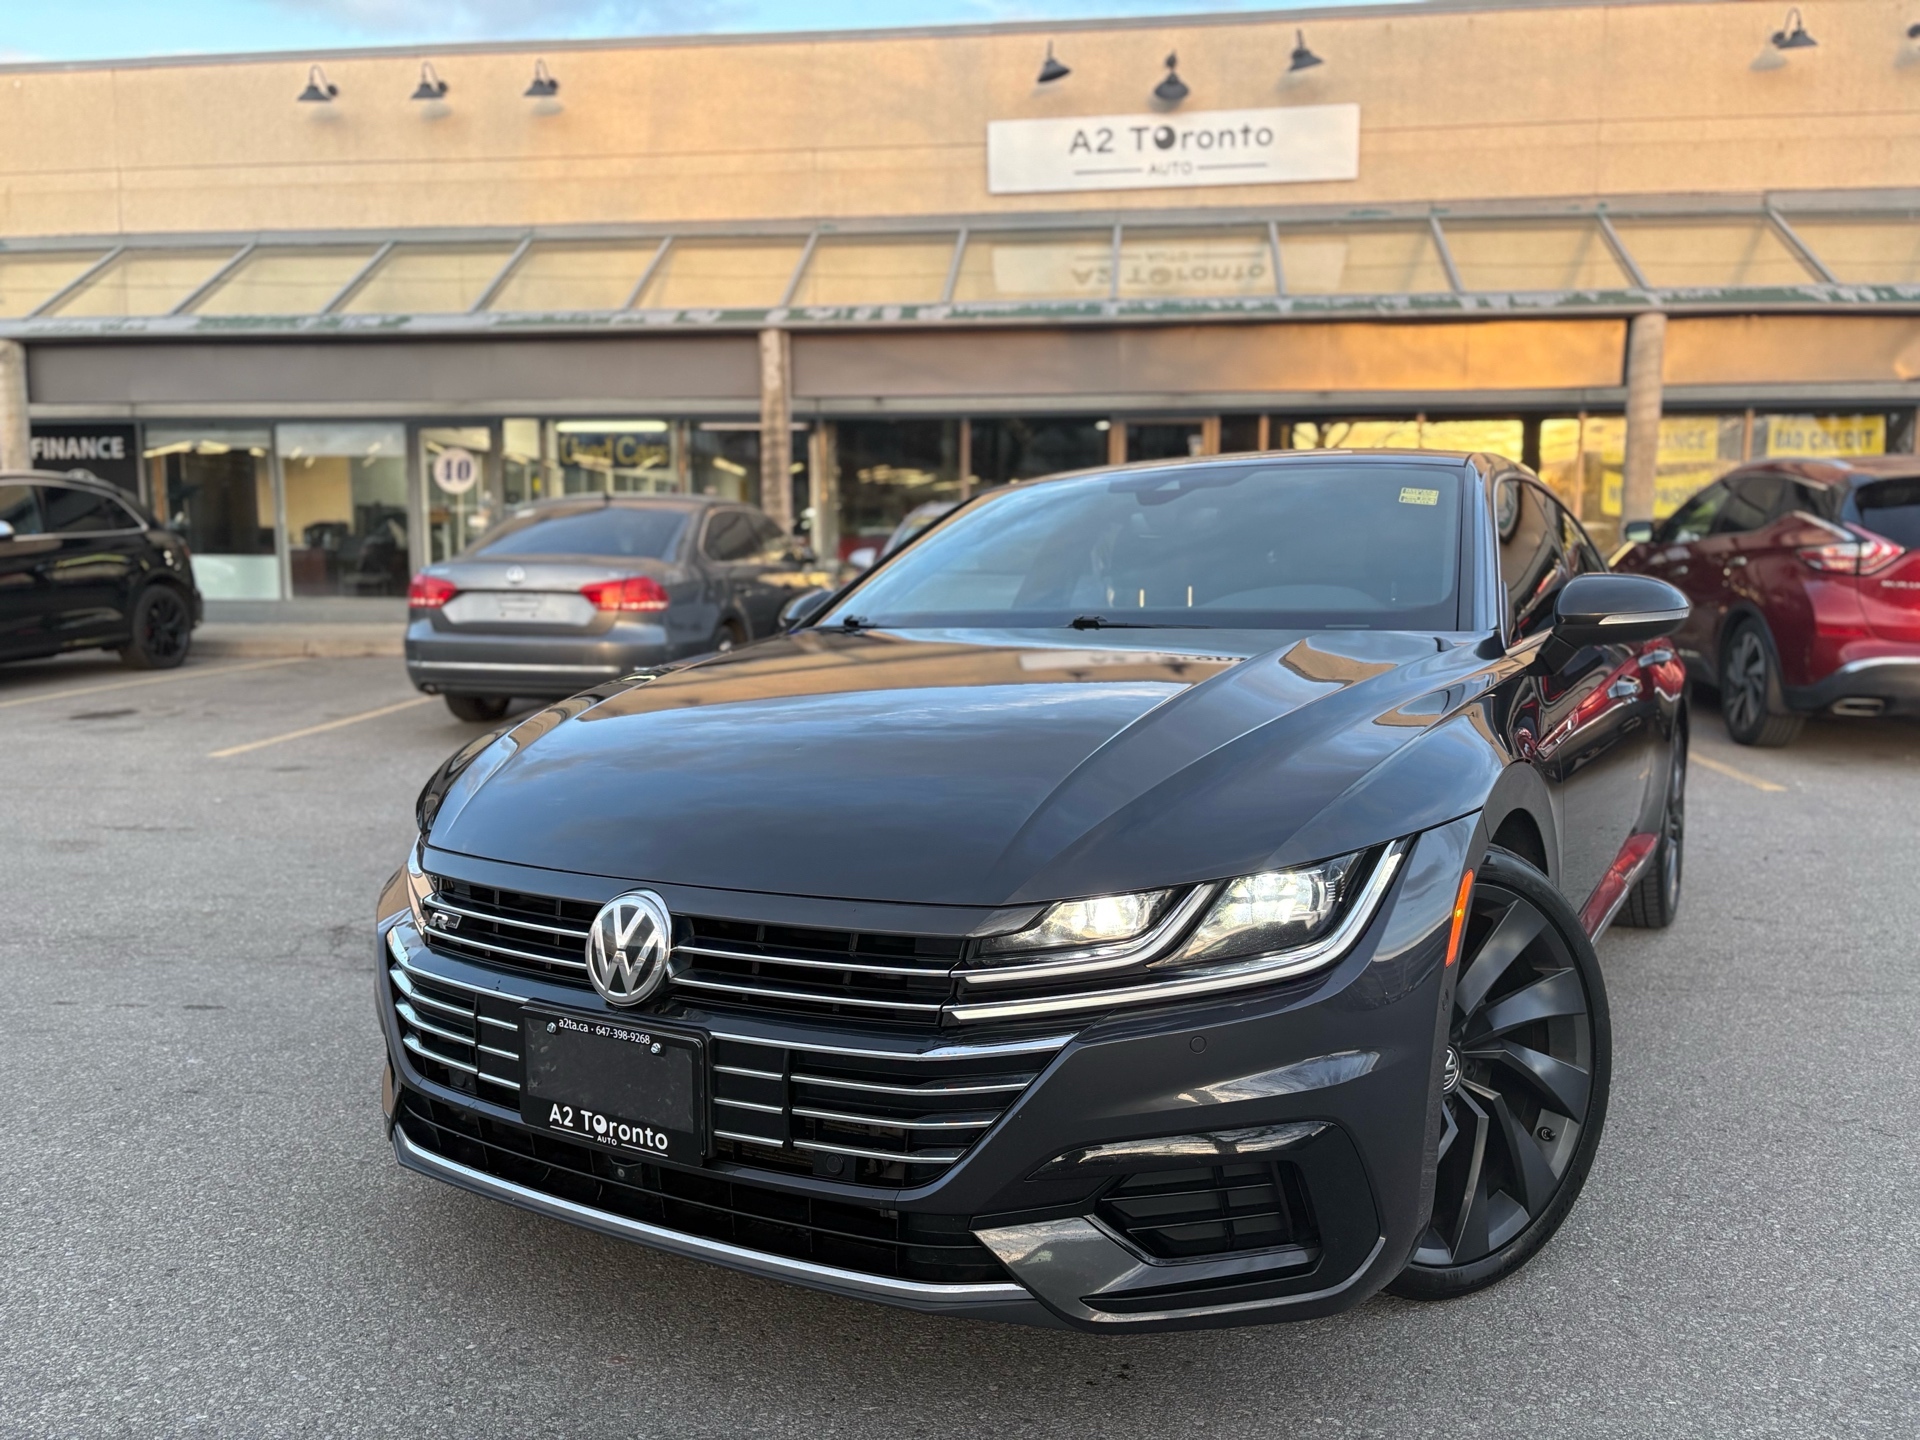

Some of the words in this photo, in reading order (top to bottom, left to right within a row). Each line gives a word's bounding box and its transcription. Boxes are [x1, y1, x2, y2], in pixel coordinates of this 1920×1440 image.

[1069, 127, 1114, 155] A2
[1148, 160, 1193, 176] AUTO
[31, 436, 124, 460] FINANCE
[558, 1018, 589, 1033] a2ta.ca
[595, 1026, 651, 1045] 647-398-9268
[549, 1103, 574, 1127] A2
[597, 1136, 617, 1146] AUTO
